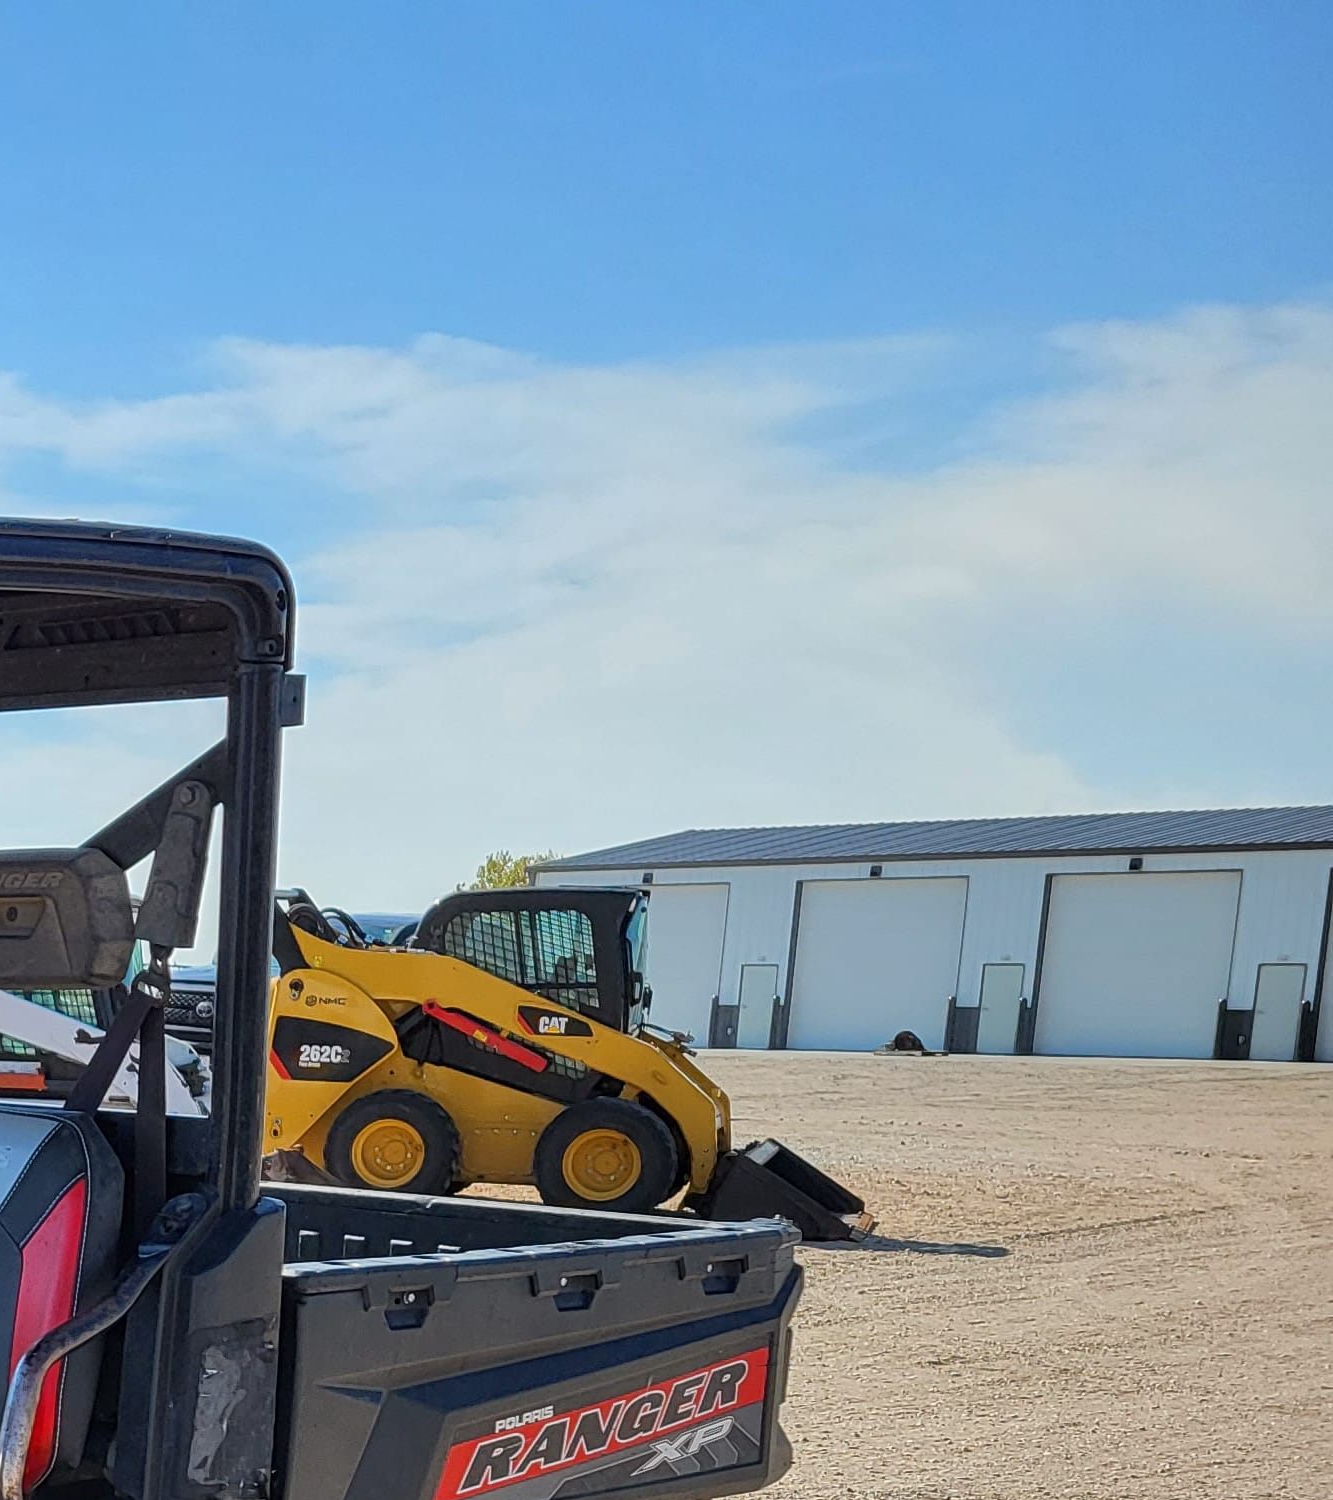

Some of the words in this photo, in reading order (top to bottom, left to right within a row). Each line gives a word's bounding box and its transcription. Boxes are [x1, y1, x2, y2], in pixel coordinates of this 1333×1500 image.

[539, 1016, 569, 1034] CAT
[456, 1359, 749, 1495] RANGER
[495, 1405, 555, 1433] POLARIS
[630, 1415, 734, 1476] XP
